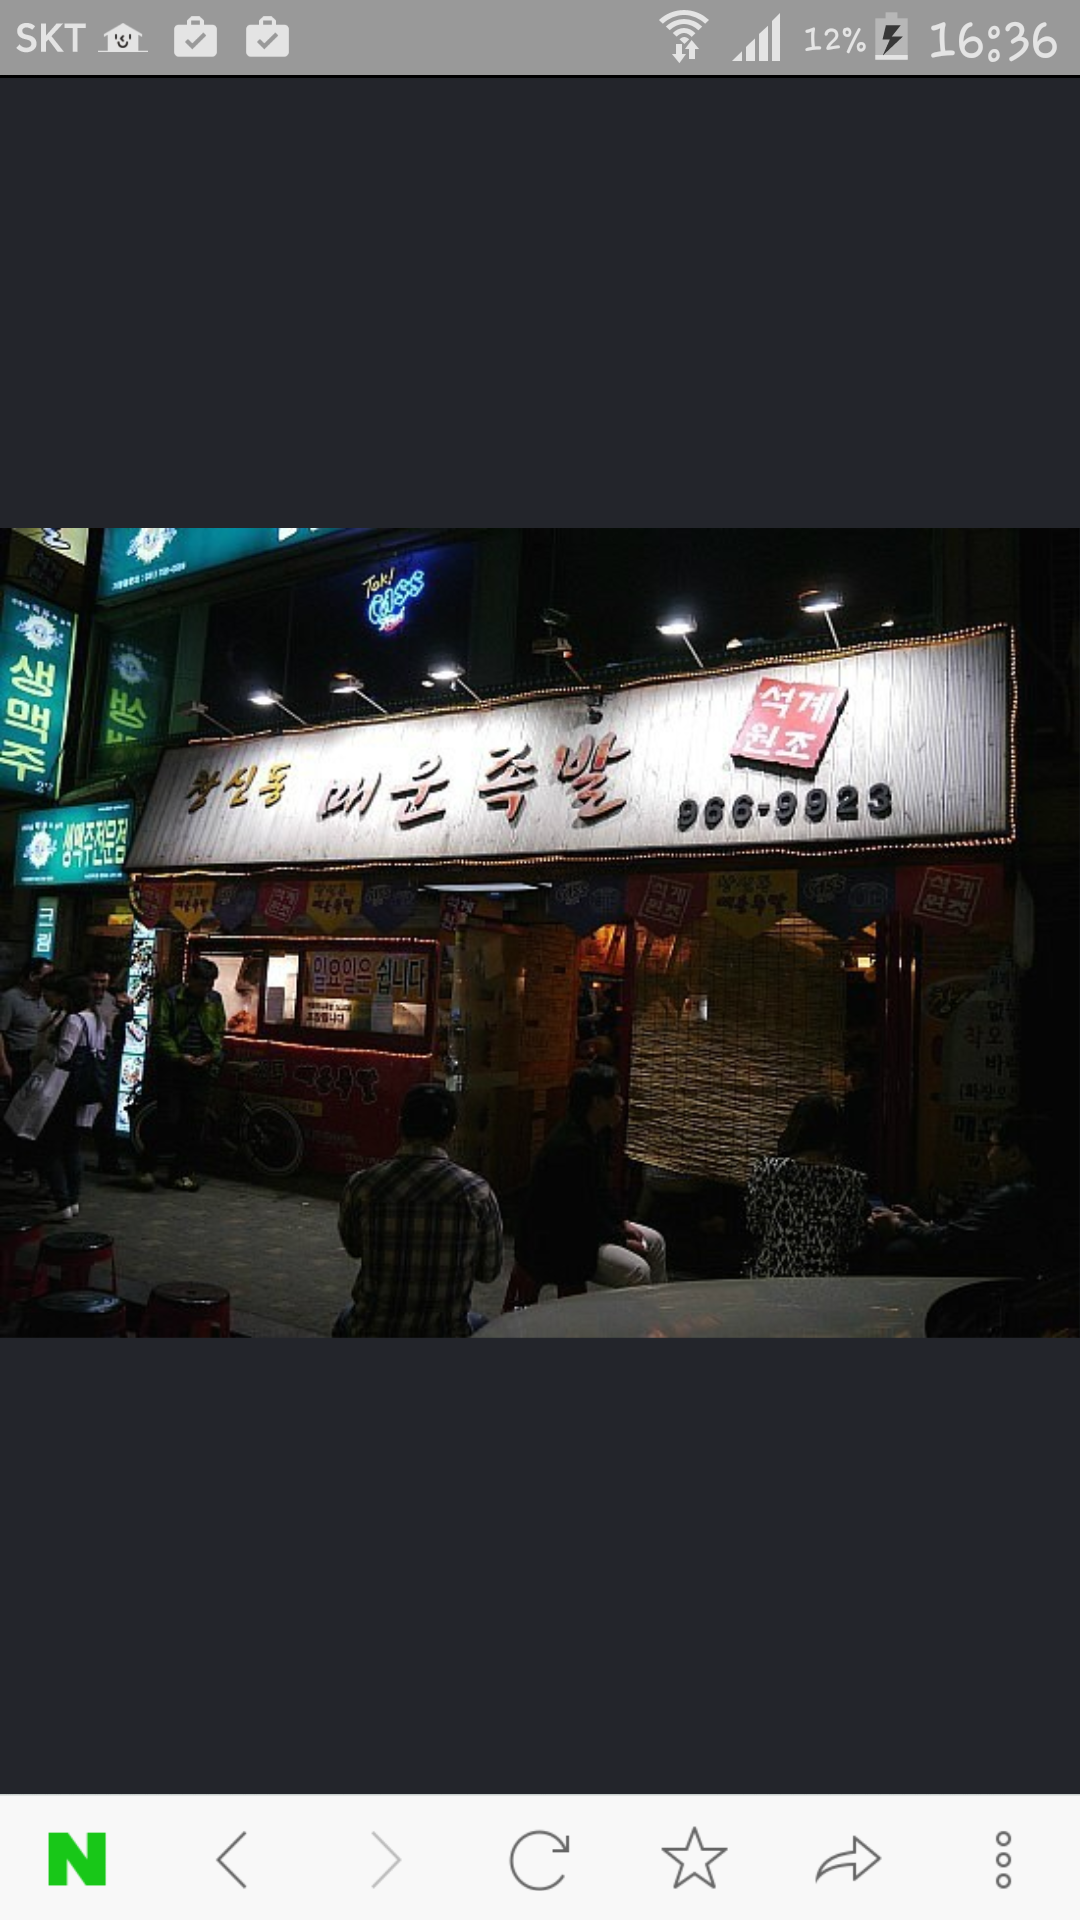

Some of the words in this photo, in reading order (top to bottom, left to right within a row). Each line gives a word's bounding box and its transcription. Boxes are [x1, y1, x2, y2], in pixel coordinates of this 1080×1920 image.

[0, 655, 57, 783] 생맥주
[760, 684, 835, 724] 석계
[743, 721, 819, 761] 원조
[187, 761, 291, 814] 창신동
[316, 755, 450, 830] 매운
[478, 731, 632, 829] 족발
[677, 783, 893, 832] 966-9923
[62, 818, 129, 868] 생맥주전문점
[36, 907, 54, 953] 크림
[313, 956, 373, 995] 일요일은
[375, 956, 427, 998] 쉽니다
